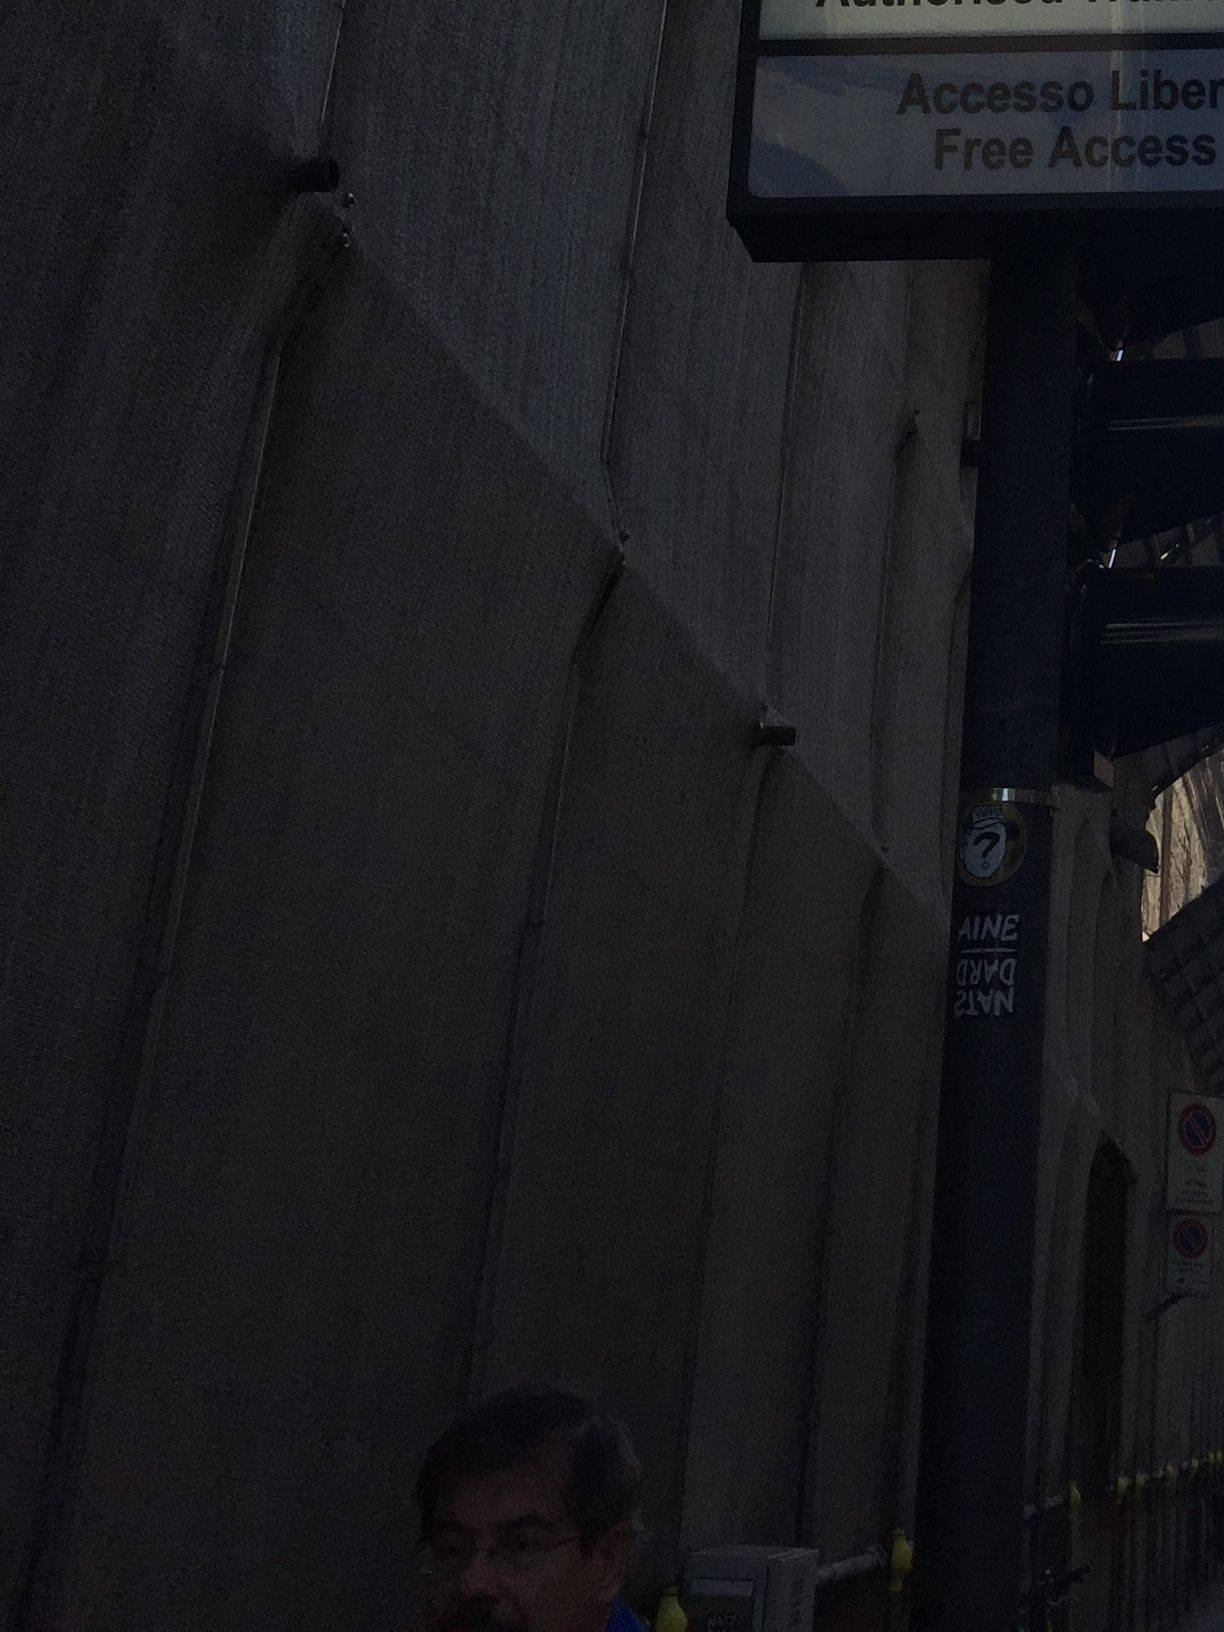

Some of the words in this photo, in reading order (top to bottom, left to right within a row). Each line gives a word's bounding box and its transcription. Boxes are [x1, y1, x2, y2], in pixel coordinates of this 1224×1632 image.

[897, 73, 1094, 115] Accesso
[934, 128, 1033, 170] Free
[1048, 126, 1217, 168] Access
